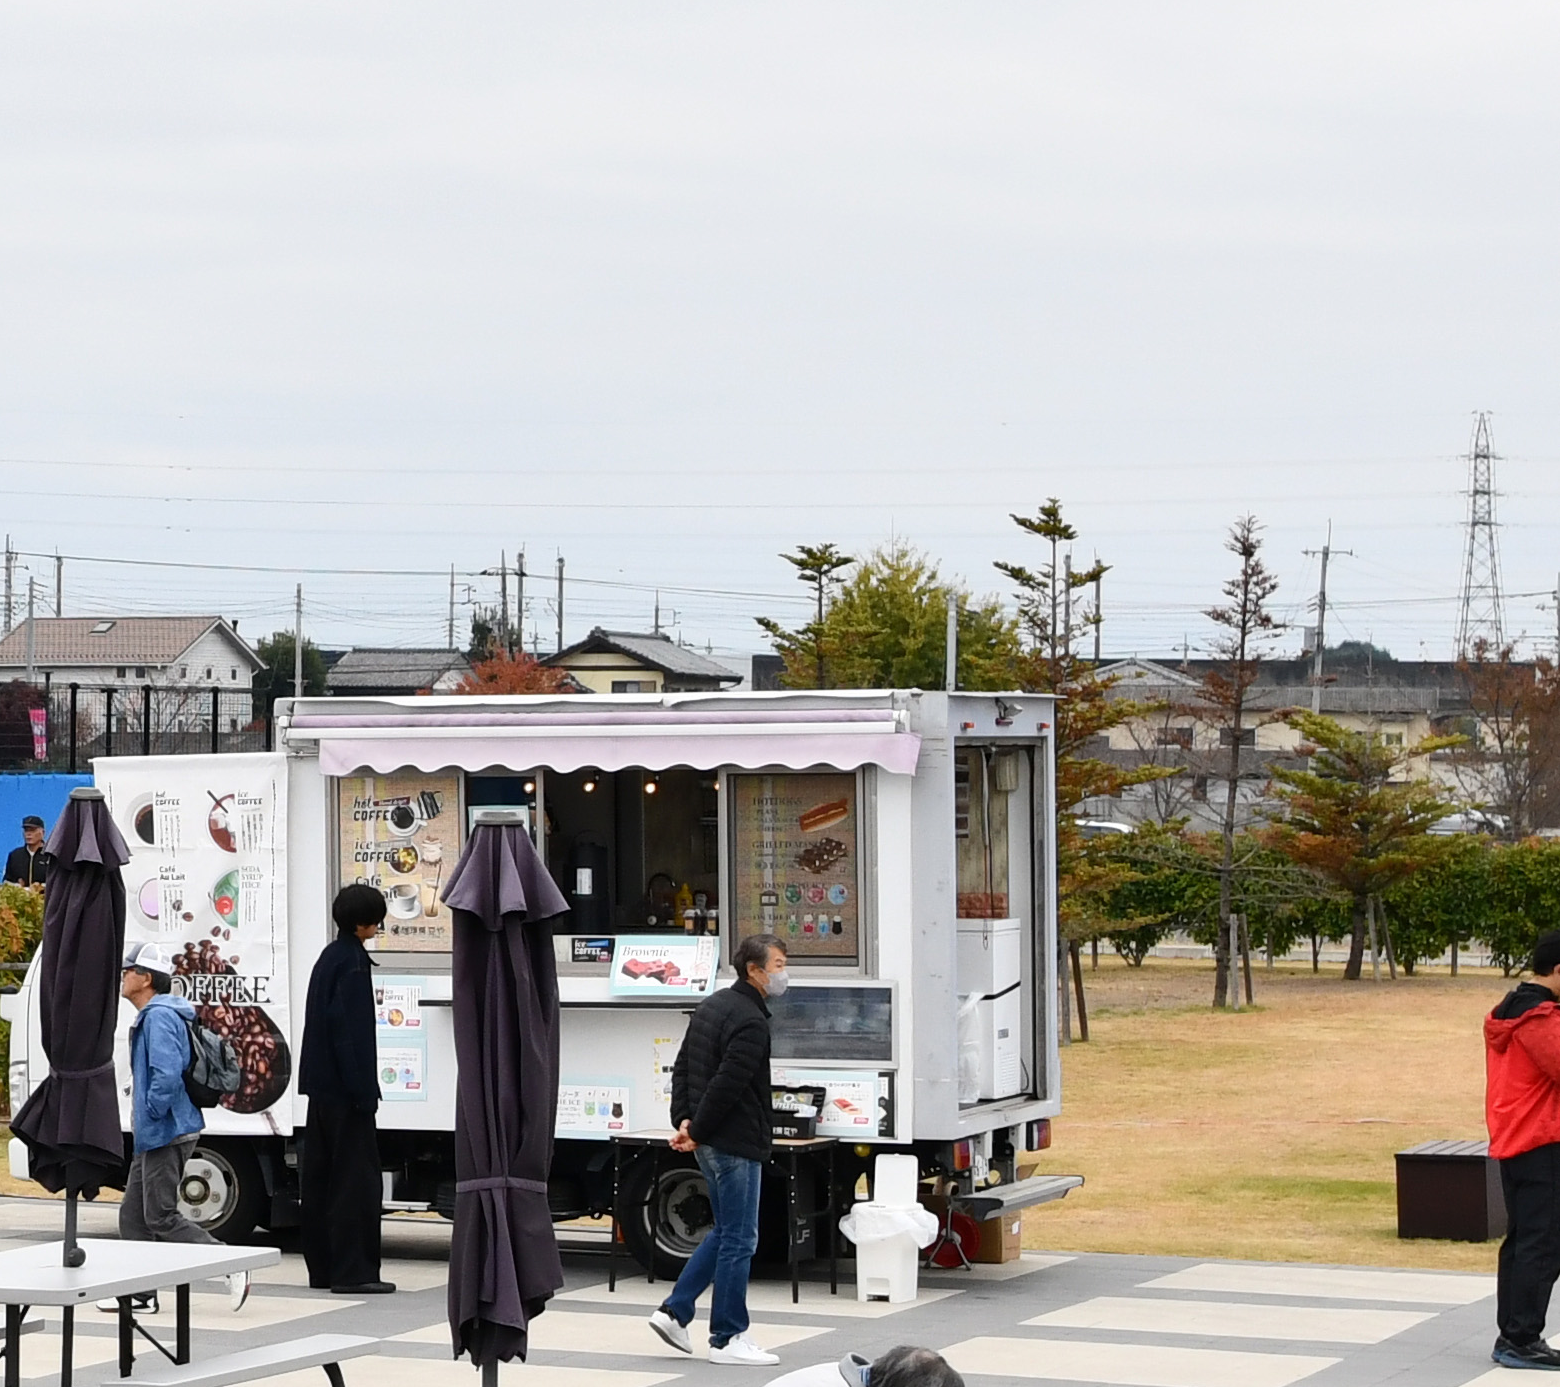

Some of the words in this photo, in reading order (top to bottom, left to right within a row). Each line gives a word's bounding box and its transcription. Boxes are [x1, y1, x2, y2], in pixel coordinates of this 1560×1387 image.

[353, 795, 373, 809] hot
[355, 838, 373, 850] ice
[354, 851, 399, 863] COFFEE
[355, 873, 383, 887] Café
[622, 946, 670, 957] Brownie
[170, 975, 271, 1004] OFFEE
